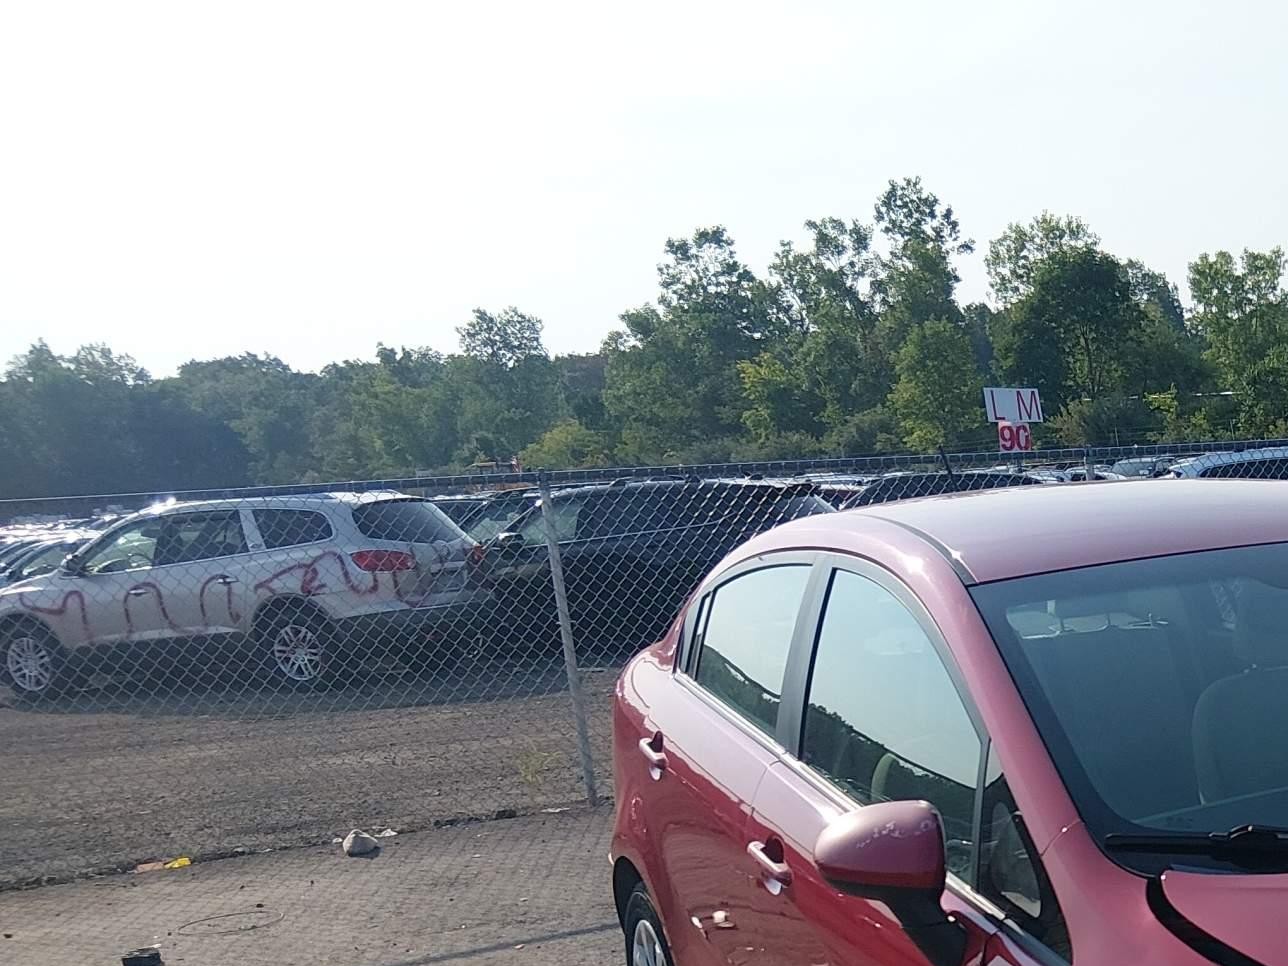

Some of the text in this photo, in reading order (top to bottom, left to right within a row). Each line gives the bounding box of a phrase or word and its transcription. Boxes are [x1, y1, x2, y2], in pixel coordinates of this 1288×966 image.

[991, 390, 1041, 421] L M
[1000, 425, 1031, 452] 90
